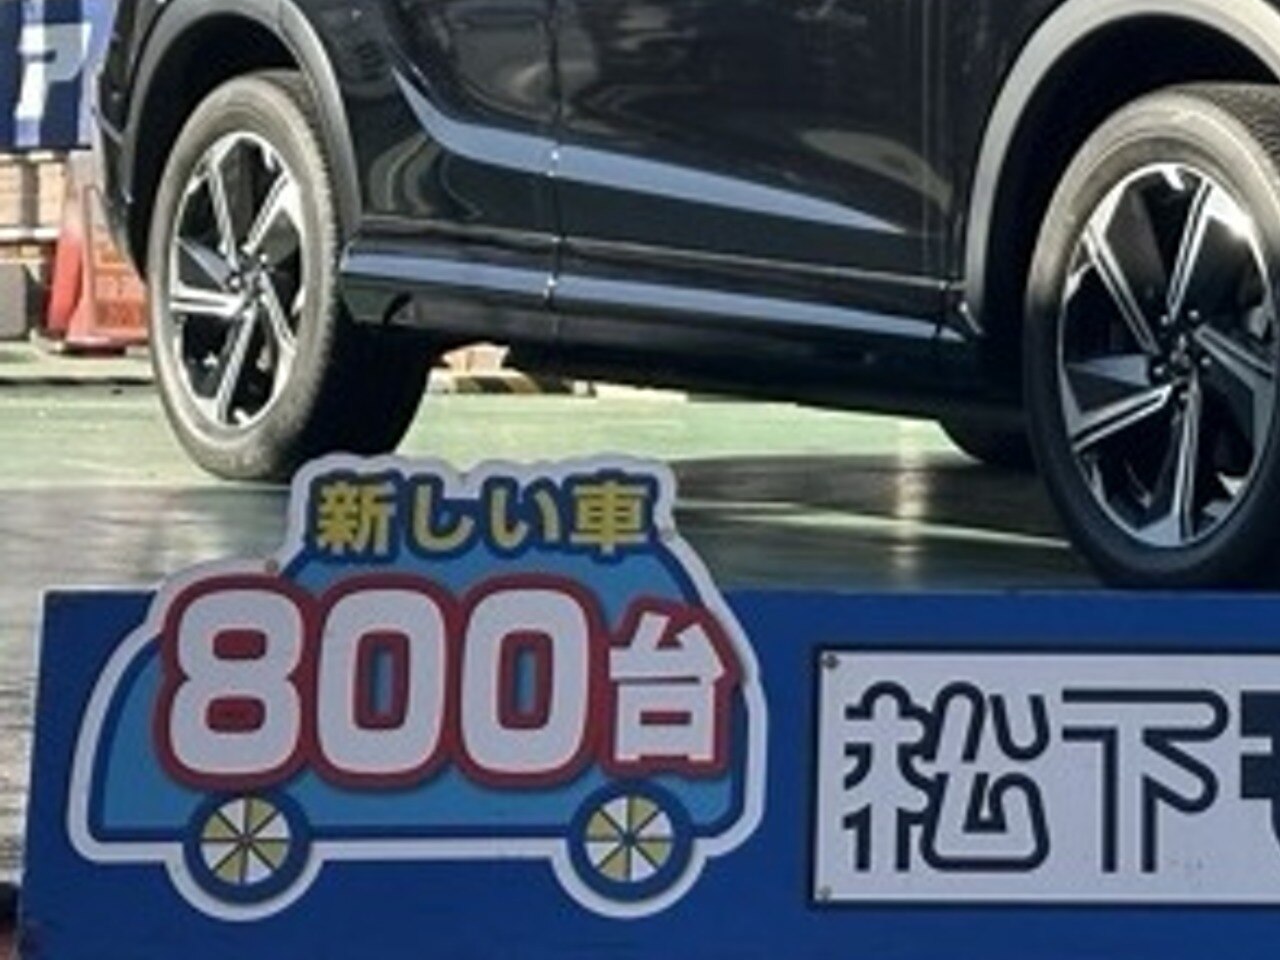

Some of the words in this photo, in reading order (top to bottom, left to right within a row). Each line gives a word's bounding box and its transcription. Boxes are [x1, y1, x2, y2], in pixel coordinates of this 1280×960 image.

[315, 478, 654, 554] 新しい車
[167, 585, 727, 778] 800台
